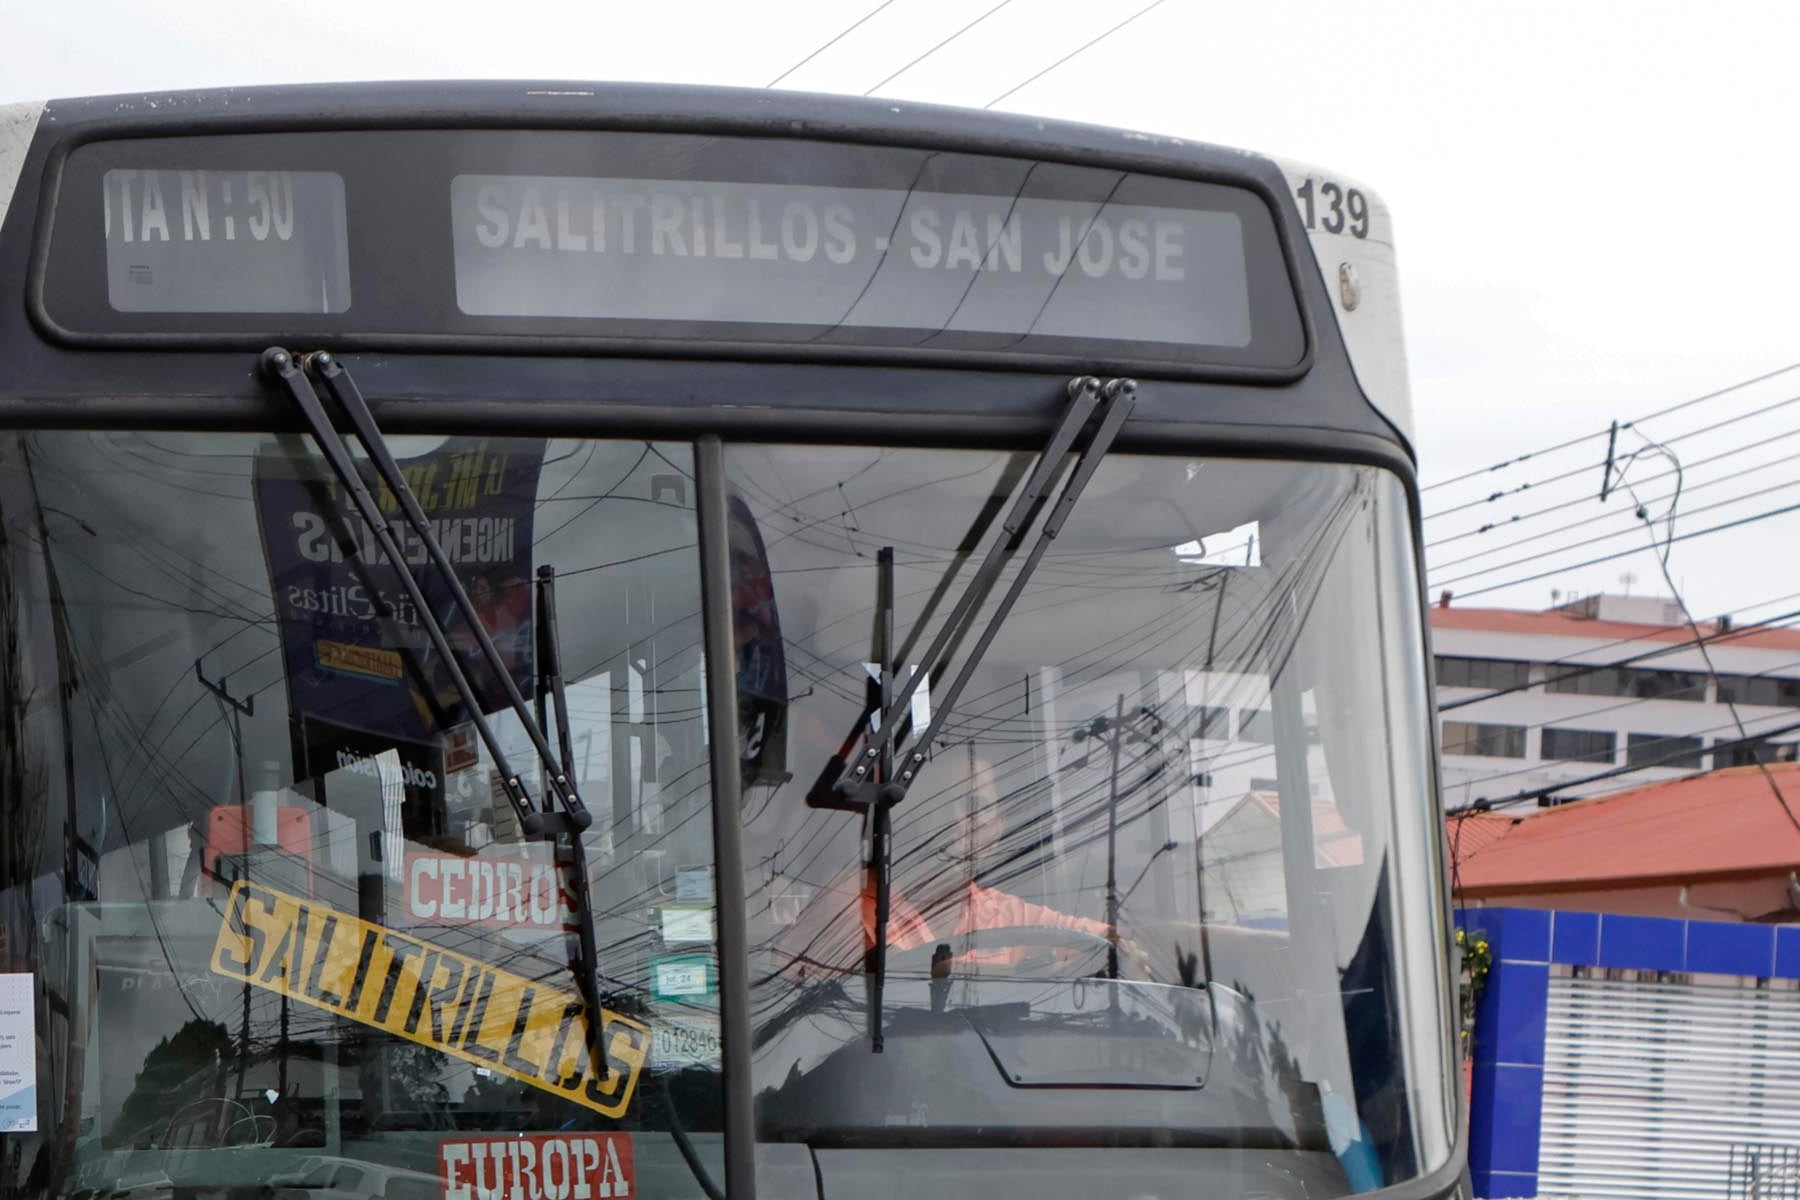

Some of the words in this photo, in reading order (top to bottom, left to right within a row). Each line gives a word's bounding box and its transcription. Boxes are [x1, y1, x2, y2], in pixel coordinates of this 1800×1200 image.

[104, 172, 170, 242] TA
[475, 184, 856, 264] SALITRILLOS
[910, 207, 1022, 272] SAN
[1043, 215, 1185, 281] JOSE
[1297, 178, 1368, 239] 139
[218, 887, 645, 1109] SALITRILLOS
